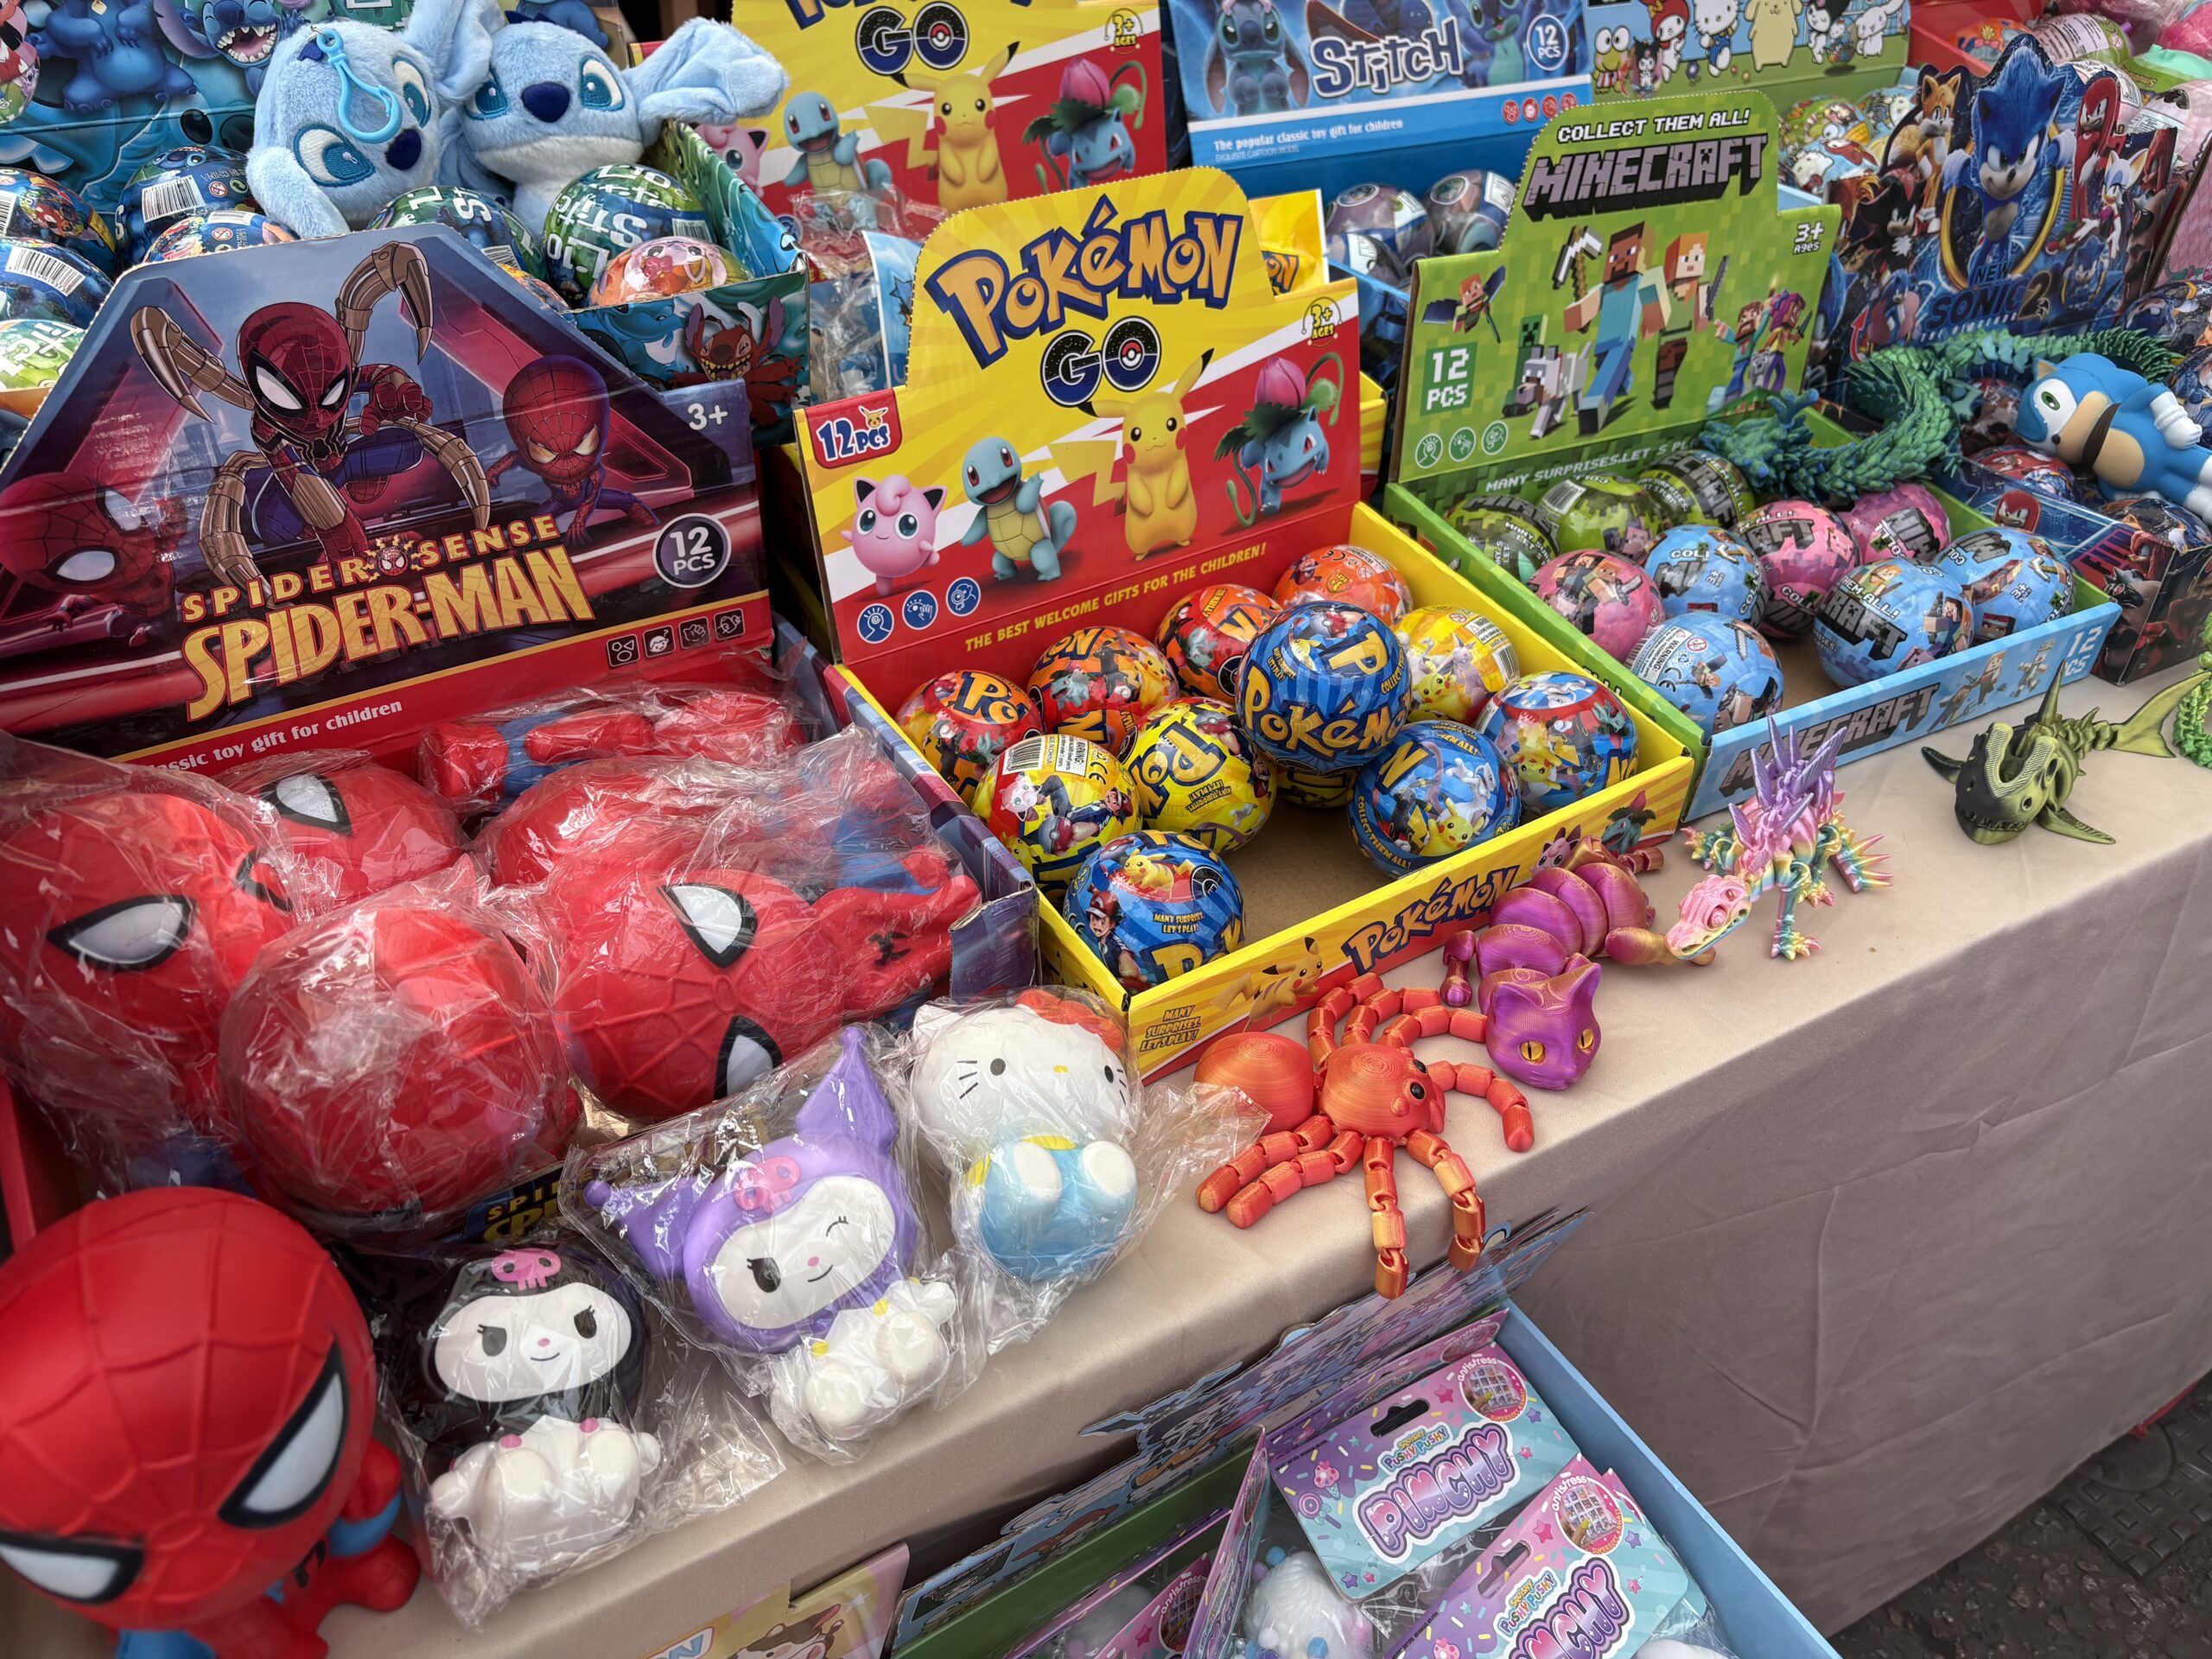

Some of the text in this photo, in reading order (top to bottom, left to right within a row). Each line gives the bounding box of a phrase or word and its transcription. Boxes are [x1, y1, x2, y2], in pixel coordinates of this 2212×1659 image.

[855, 1, 969, 75] GO
[1535, 23, 1559, 47] 12
[1537, 44, 1561, 60] PCS
[1213, 118, 1404, 151] The popular classic toy gift for children
[1557, 108, 1751, 144] COLLECT THEM ALL!
[1522, 134, 1769, 222] MINECRAFT
[1793, 221, 1825, 244] 3+
[1311, 303, 1333, 328] 3+
[1312, 323, 1336, 340] AGES
[1040, 316, 1162, 408] GO
[1432, 347, 1470, 382] 12
[1426, 385, 1468, 411] PCS
[688, 403, 728, 431] 3+
[1485, 474, 1531, 493] MANY
[667, 526, 710, 562] 12
[181, 514, 561, 624] SPIDER SENSE
[671, 549, 716, 577] PCS
[964, 541, 1268, 653] THE BEST WELCOME GIFTS FOR THE CHILDREN!
[178, 544, 594, 722] SPIDER-MAN
[2066, 625, 2103, 658] 12
[2063, 654, 2091, 677] CS
[147, 700, 404, 772] assic toy gift for children
[1162, 1005, 1196, 1022] MANY
[1140, 1028, 1198, 1053] LET'S PLAY!
[1457, 1356, 1498, 1382] antistress
[1382, 1426, 1450, 1470] PUSHY PUSHY
[1359, 1425, 1513, 1554] PINCHY
[1551, 1475, 1588, 1512] antistress
[1499, 1571, 1556, 1634] PUSHY PUSHY
[1510, 1580, 1535, 1607] SQUISHY
